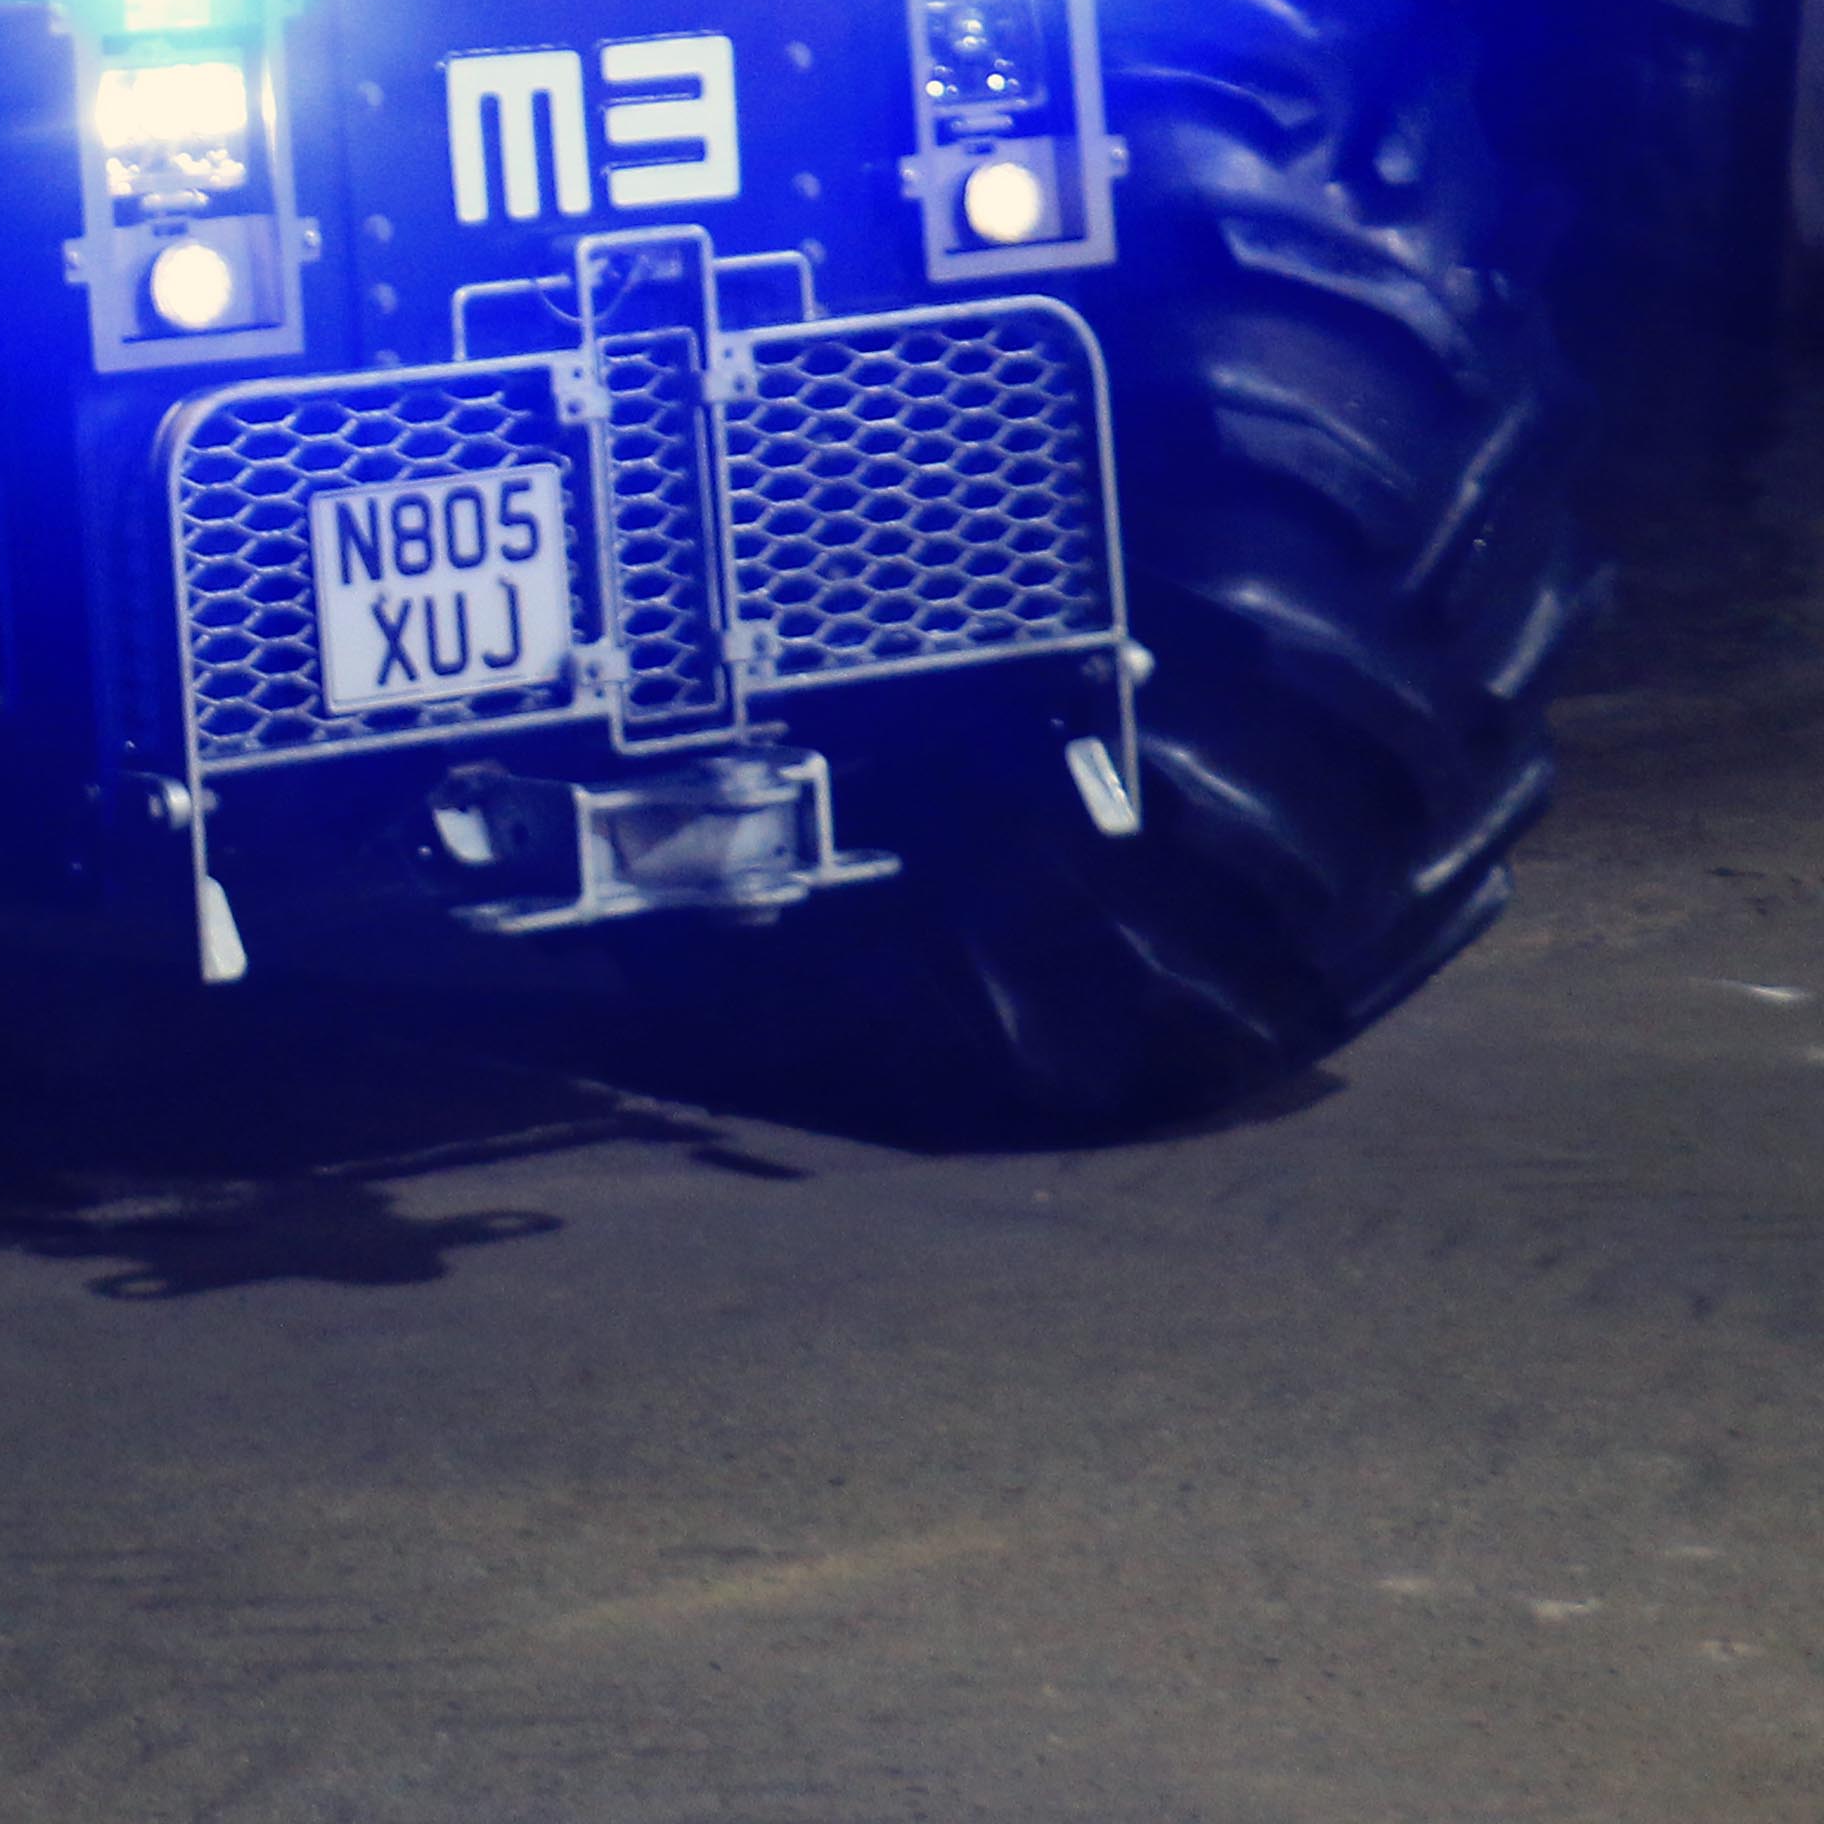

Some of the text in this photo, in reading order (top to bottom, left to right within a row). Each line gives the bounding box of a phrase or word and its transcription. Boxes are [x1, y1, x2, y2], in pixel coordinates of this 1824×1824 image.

[446, 35, 740, 222] M3
[335, 479, 540, 585] N805
[371, 579, 521, 686] XUJ
